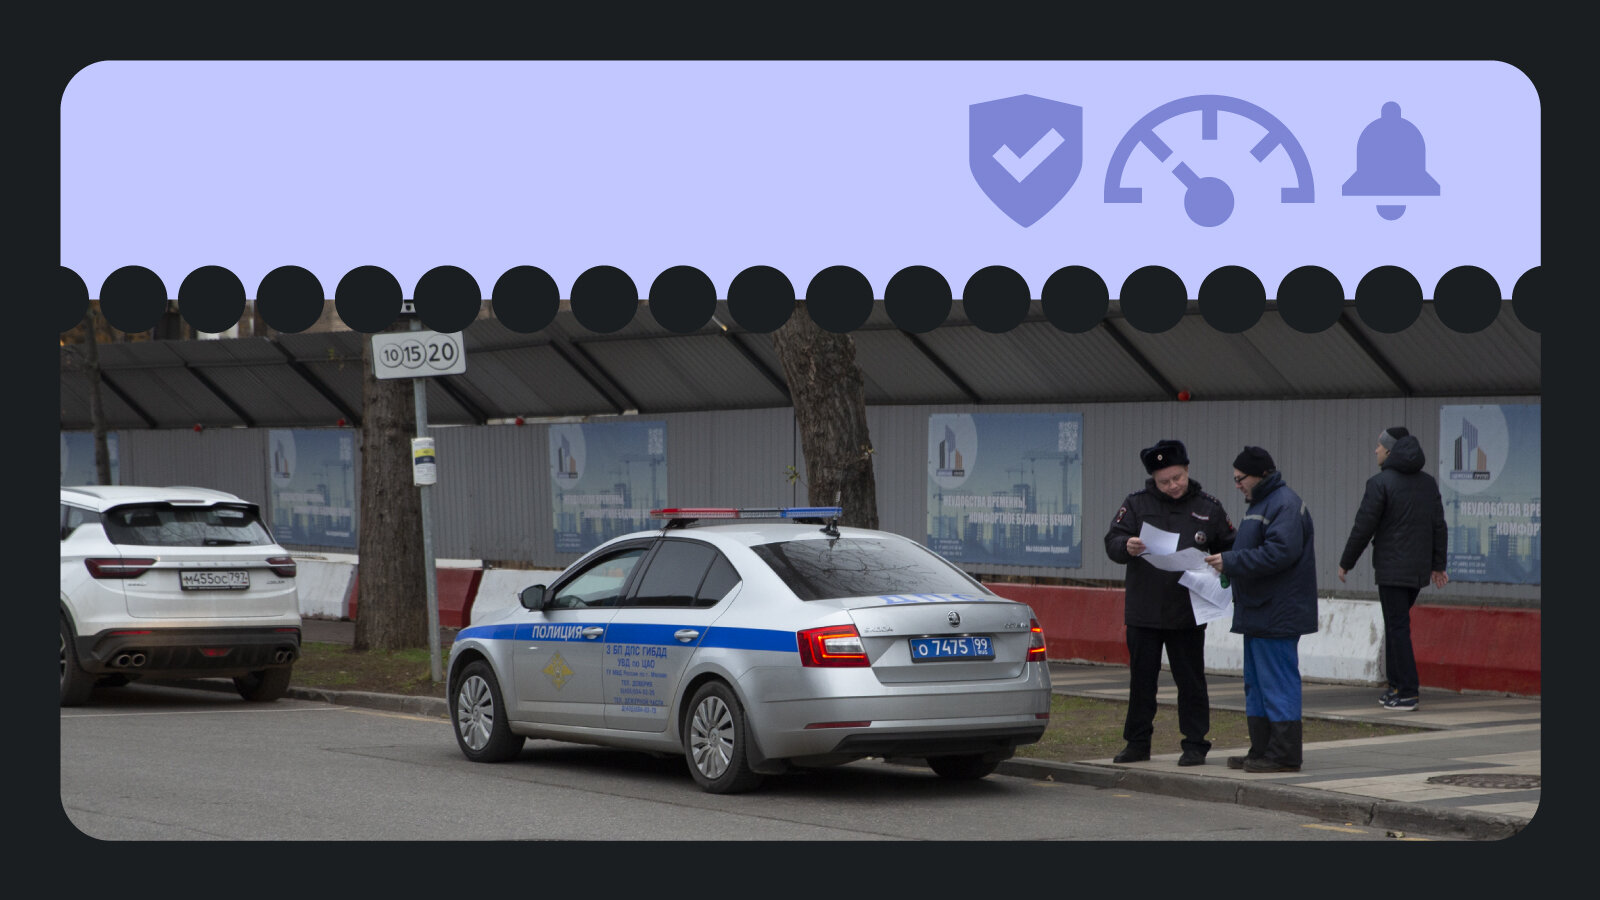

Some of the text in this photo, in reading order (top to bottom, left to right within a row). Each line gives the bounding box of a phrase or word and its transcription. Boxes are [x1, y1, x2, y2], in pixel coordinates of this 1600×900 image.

[384, 342, 454, 362] 10 15 20
[1461, 502, 1520, 517] НЕУДОБСТВА
[229, 572, 246, 580] 797
[532, 625, 583, 642] ПОЛИЦИЯ
[606, 645, 667, 658] 3 БП ДПС ГИБДД
[931, 639, 969, 655] 7475
[974, 638, 988, 650] 99
[618, 658, 630, 667] УВД
[642, 659, 655, 669] ЦАО
